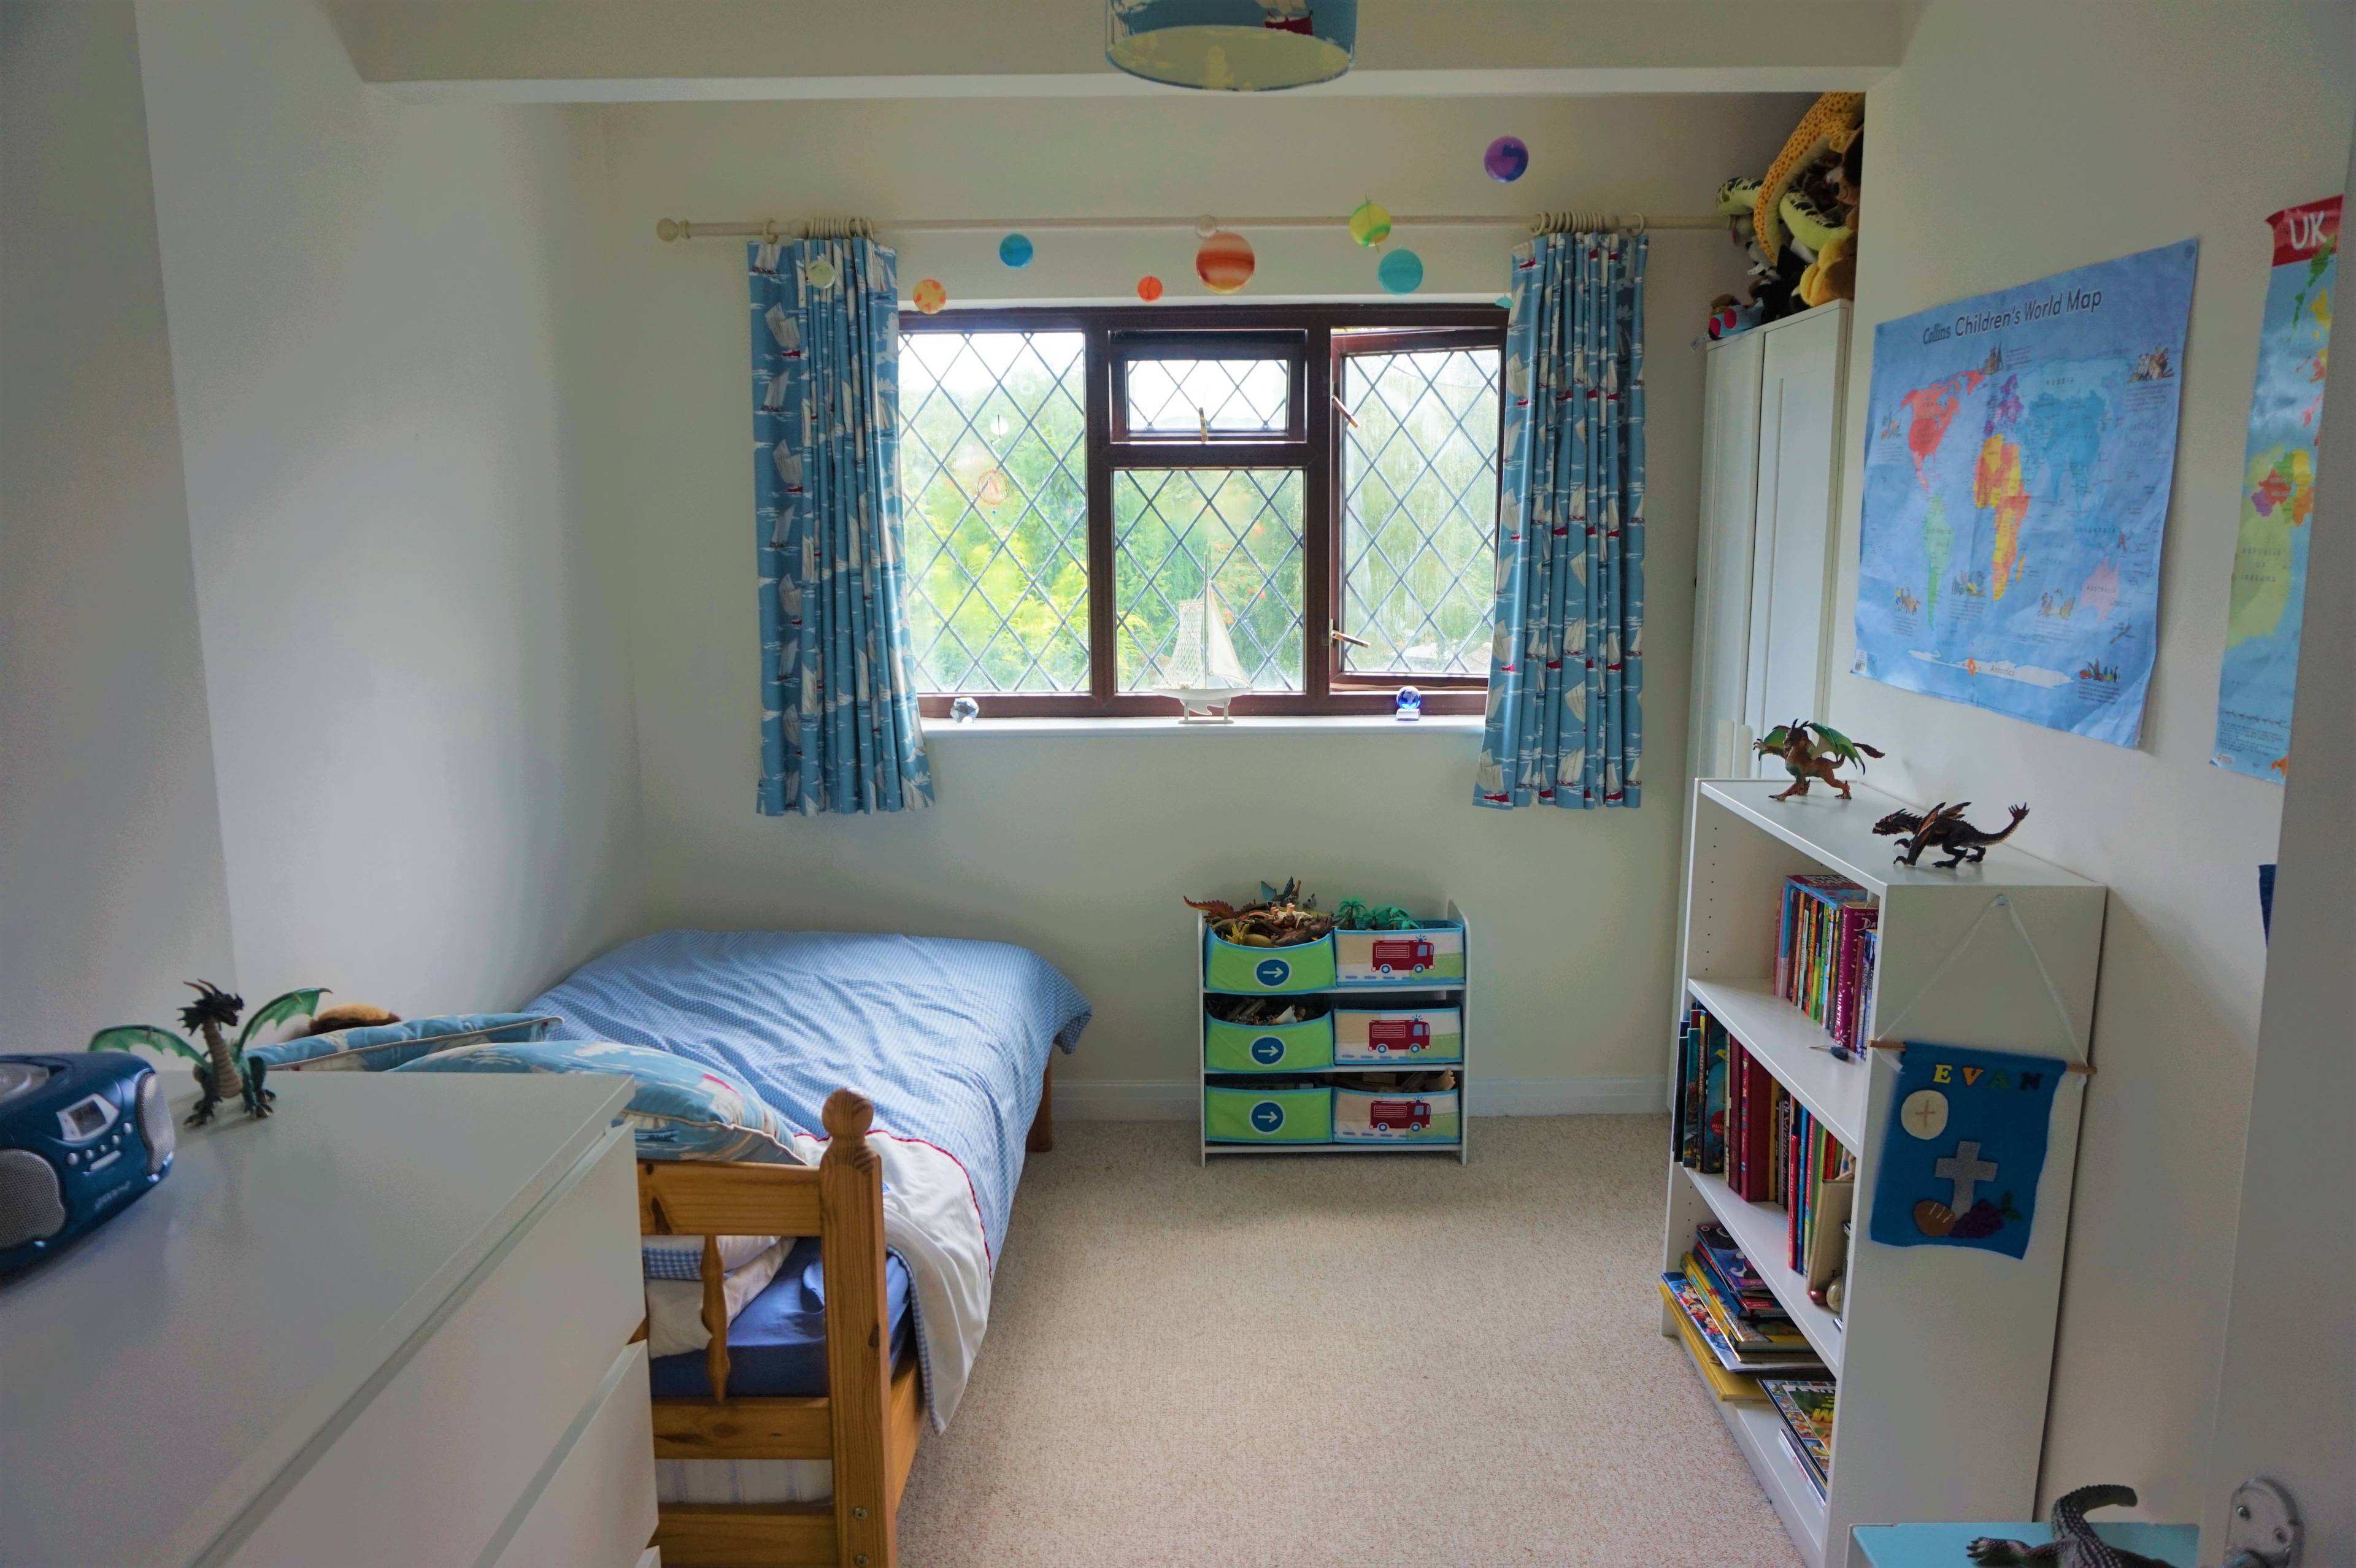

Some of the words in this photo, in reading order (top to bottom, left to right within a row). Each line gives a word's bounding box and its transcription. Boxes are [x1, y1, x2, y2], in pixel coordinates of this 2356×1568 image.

[2289, 210, 2328, 250] UK
[1923, 323, 1951, 345] Collins
[1955, 306, 2020, 337] Children's
[2025, 293, 2062, 321] World
[2066, 288, 2102, 313] Map
[1933, 1064, 2044, 1091] EVAN
